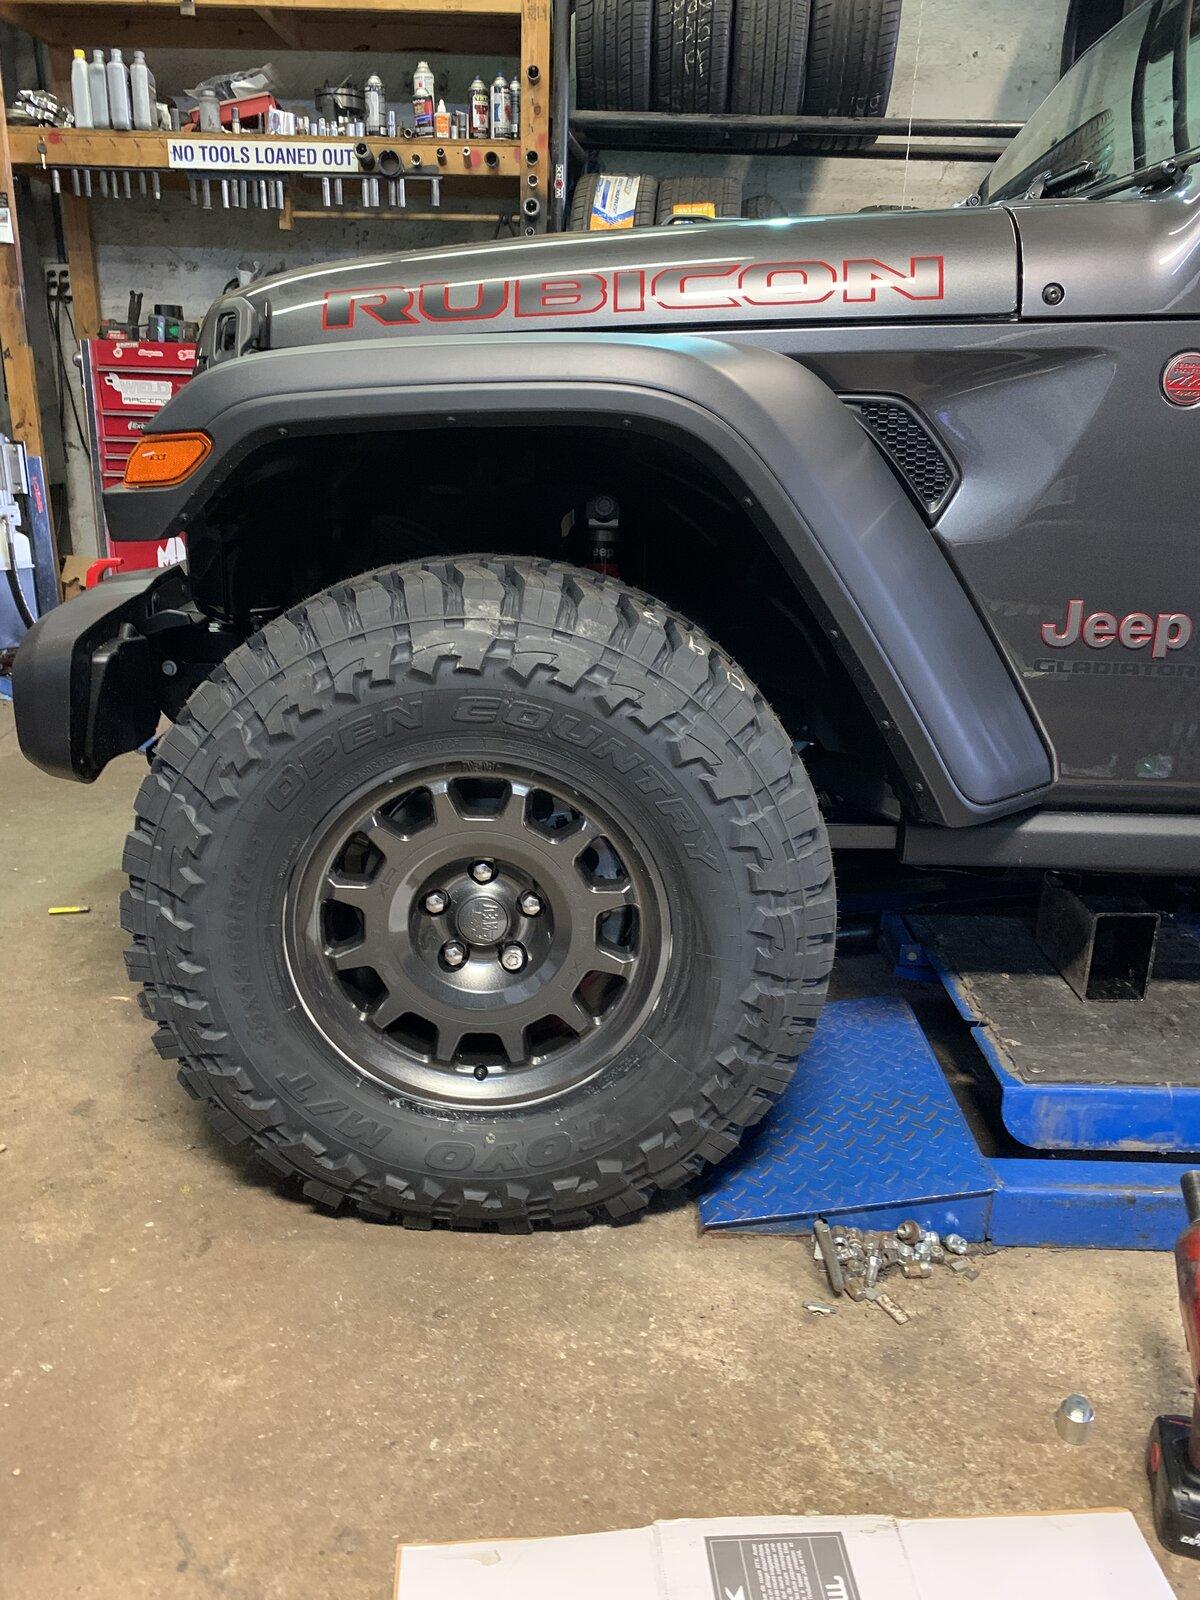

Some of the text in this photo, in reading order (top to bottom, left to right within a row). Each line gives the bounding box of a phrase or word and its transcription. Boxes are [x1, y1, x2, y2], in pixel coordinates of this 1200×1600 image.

[171, 145, 353, 166] NO TOOLS LOANED OUT
[321, 254, 945, 330] RUBICON
[1041, 599, 1193, 660] Jeep
[1033, 658, 1198, 678] GLADIATOR
[264, 695, 722, 874] OPEN COUNTRY
[276, 1073, 392, 1150] M/T
[424, 1114, 623, 1173] TOYO
